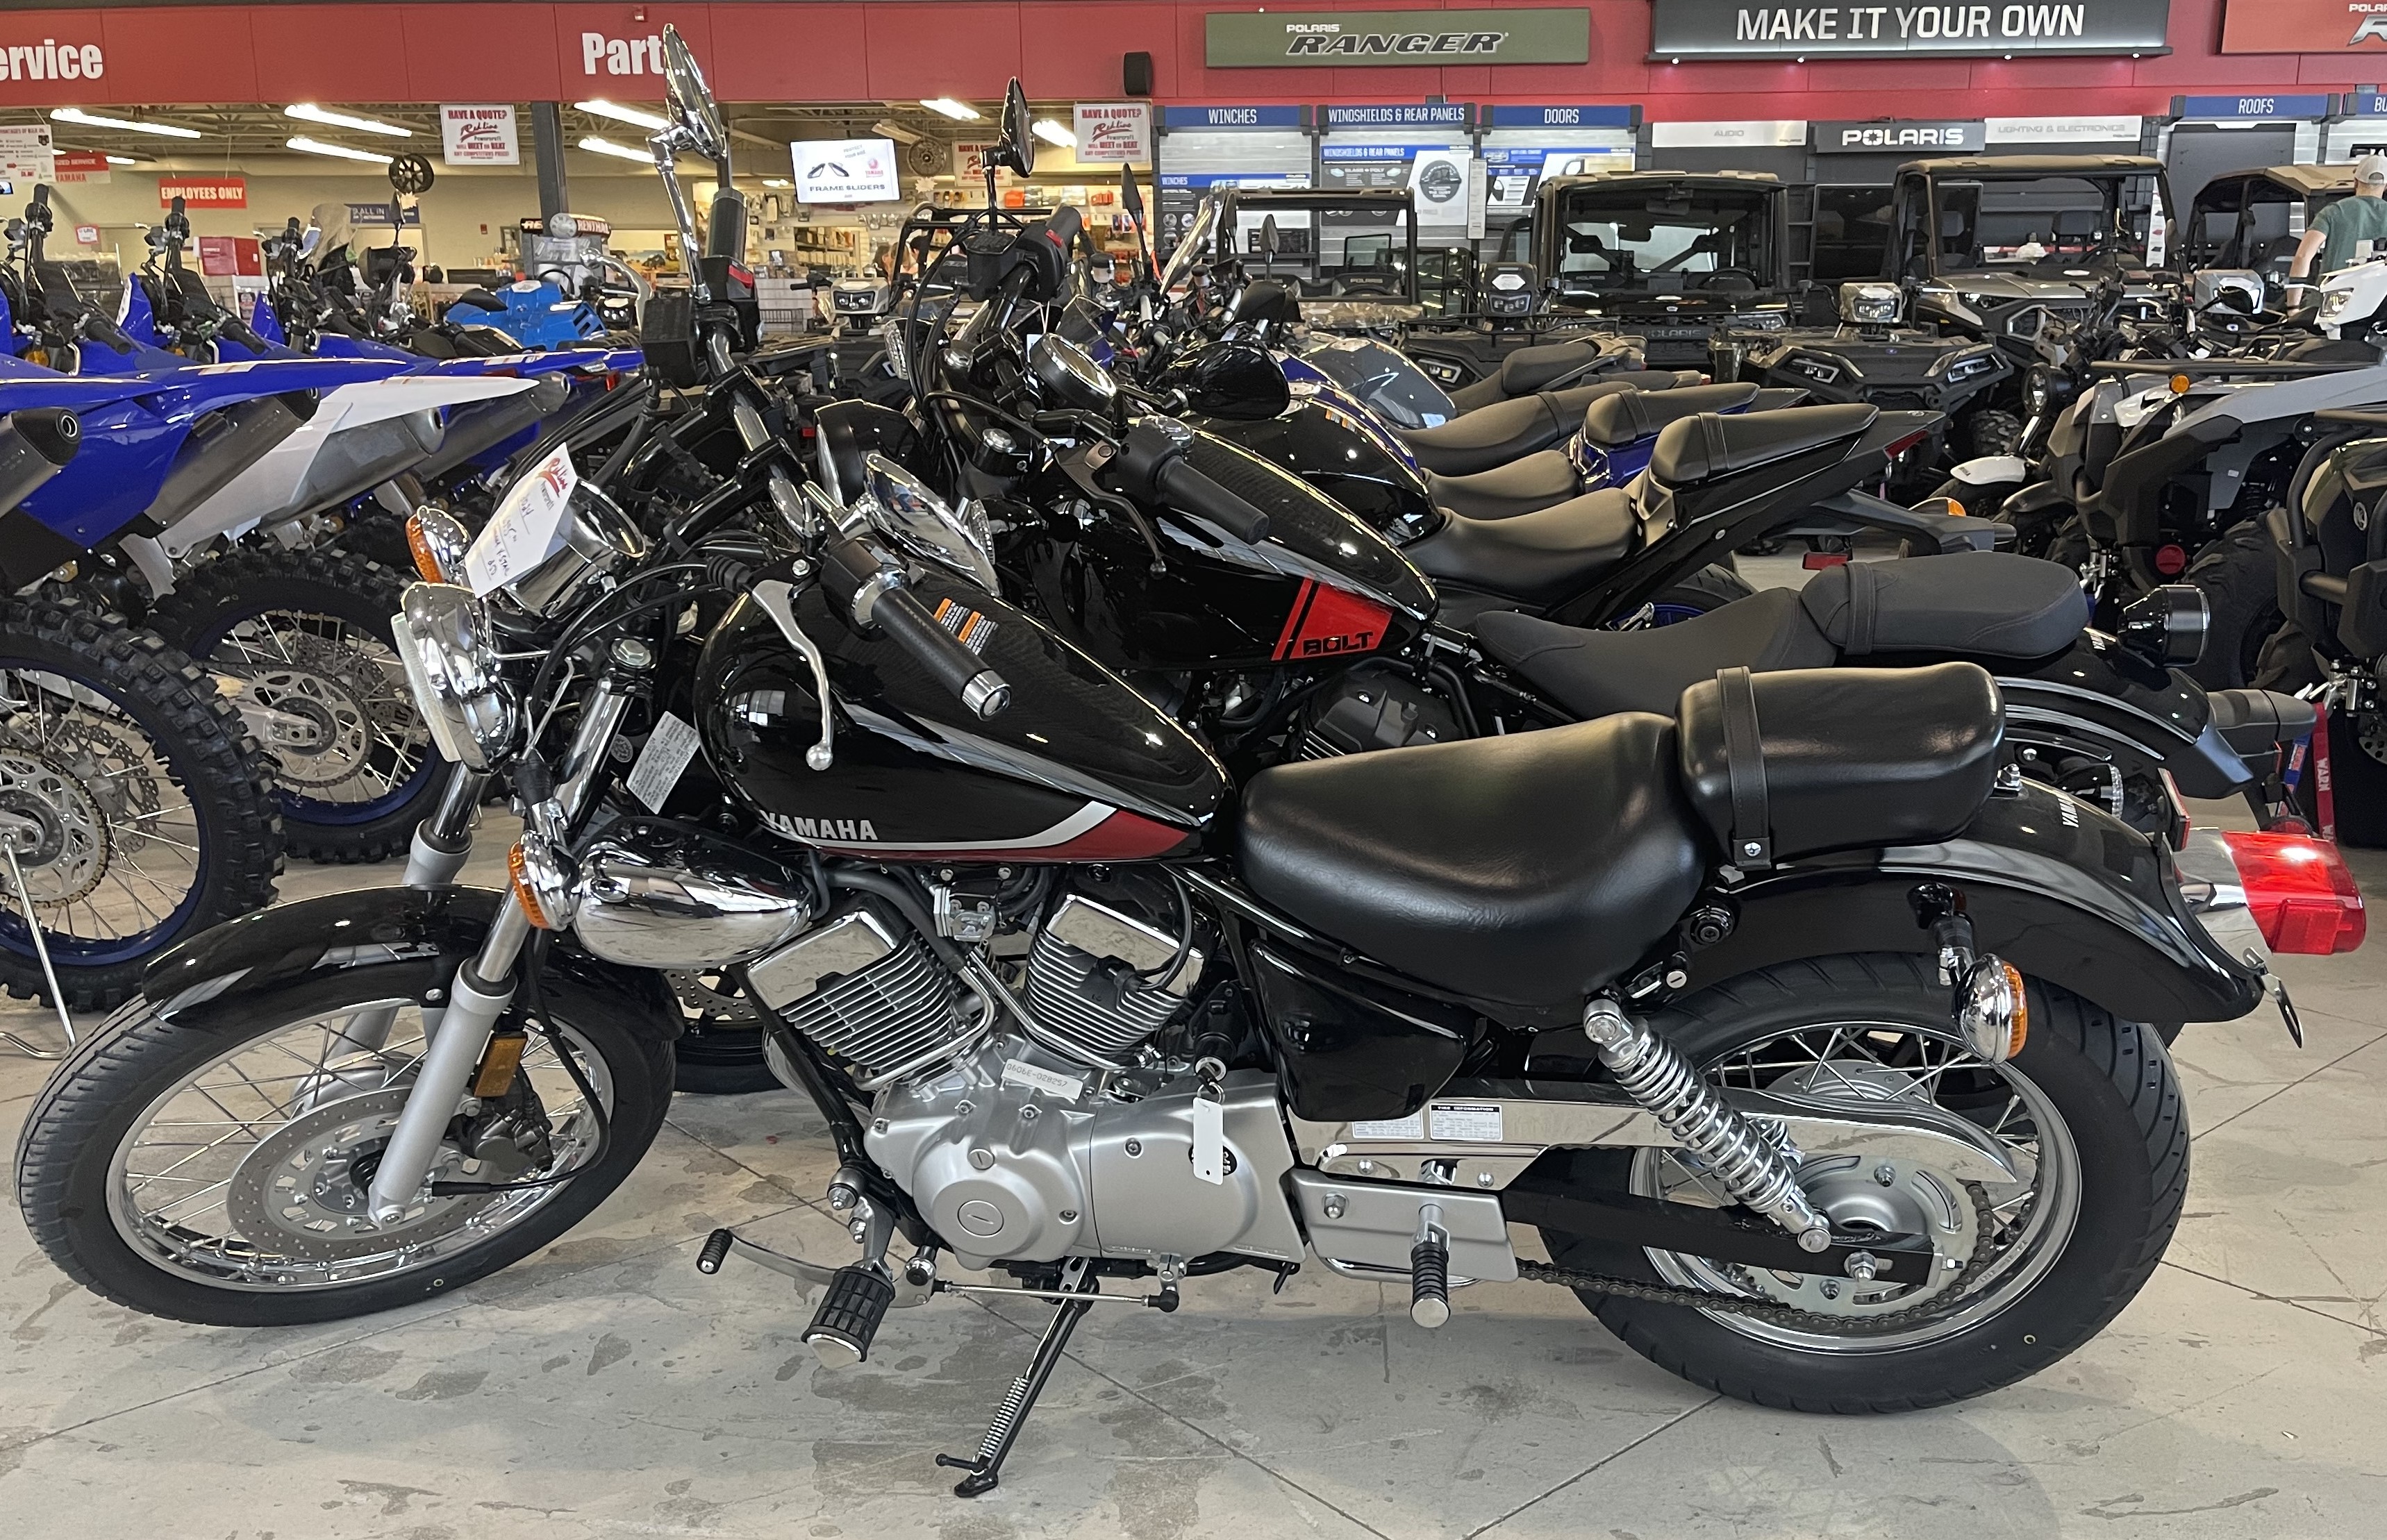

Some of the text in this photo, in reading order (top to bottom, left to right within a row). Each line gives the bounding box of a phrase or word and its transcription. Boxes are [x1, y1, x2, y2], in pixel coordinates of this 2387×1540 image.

[1286, 24, 1340, 33] POLARIS
[1736, 4, 2084, 40] MAKE IT YOUR OWN
[1286, 32, 1504, 56] RANGER
[582, 33, 664, 75] Part
[1082, 108, 1141, 119] HAVE A QUOTE?
[2238, 98, 2274, 114] ROOFS
[448, 110, 507, 120] HAVE A QUOTE?
[1208, 108, 1257, 124] WINCHES
[1328, 107, 1465, 122] WINDSHIELDS & REAR PANELS
[1544, 109, 1579, 124] DOORS
[1842, 128, 1964, 147] POLARIS
[1323, 148, 1363, 157] WINDSHIELDS
[1368, 148, 1383, 156] REAR
[1383, 148, 1404, 156] PANELS
[1162, 176, 1188, 185] WINCHES
[160, 187, 243, 200] EMPLOYEES ONLY
[577, 219, 610, 234] RENTHAL
[1304, 631, 1373, 655] BOLT
[2316, 757, 2331, 792] WARN
[759, 809, 878, 840] YAMAHA
